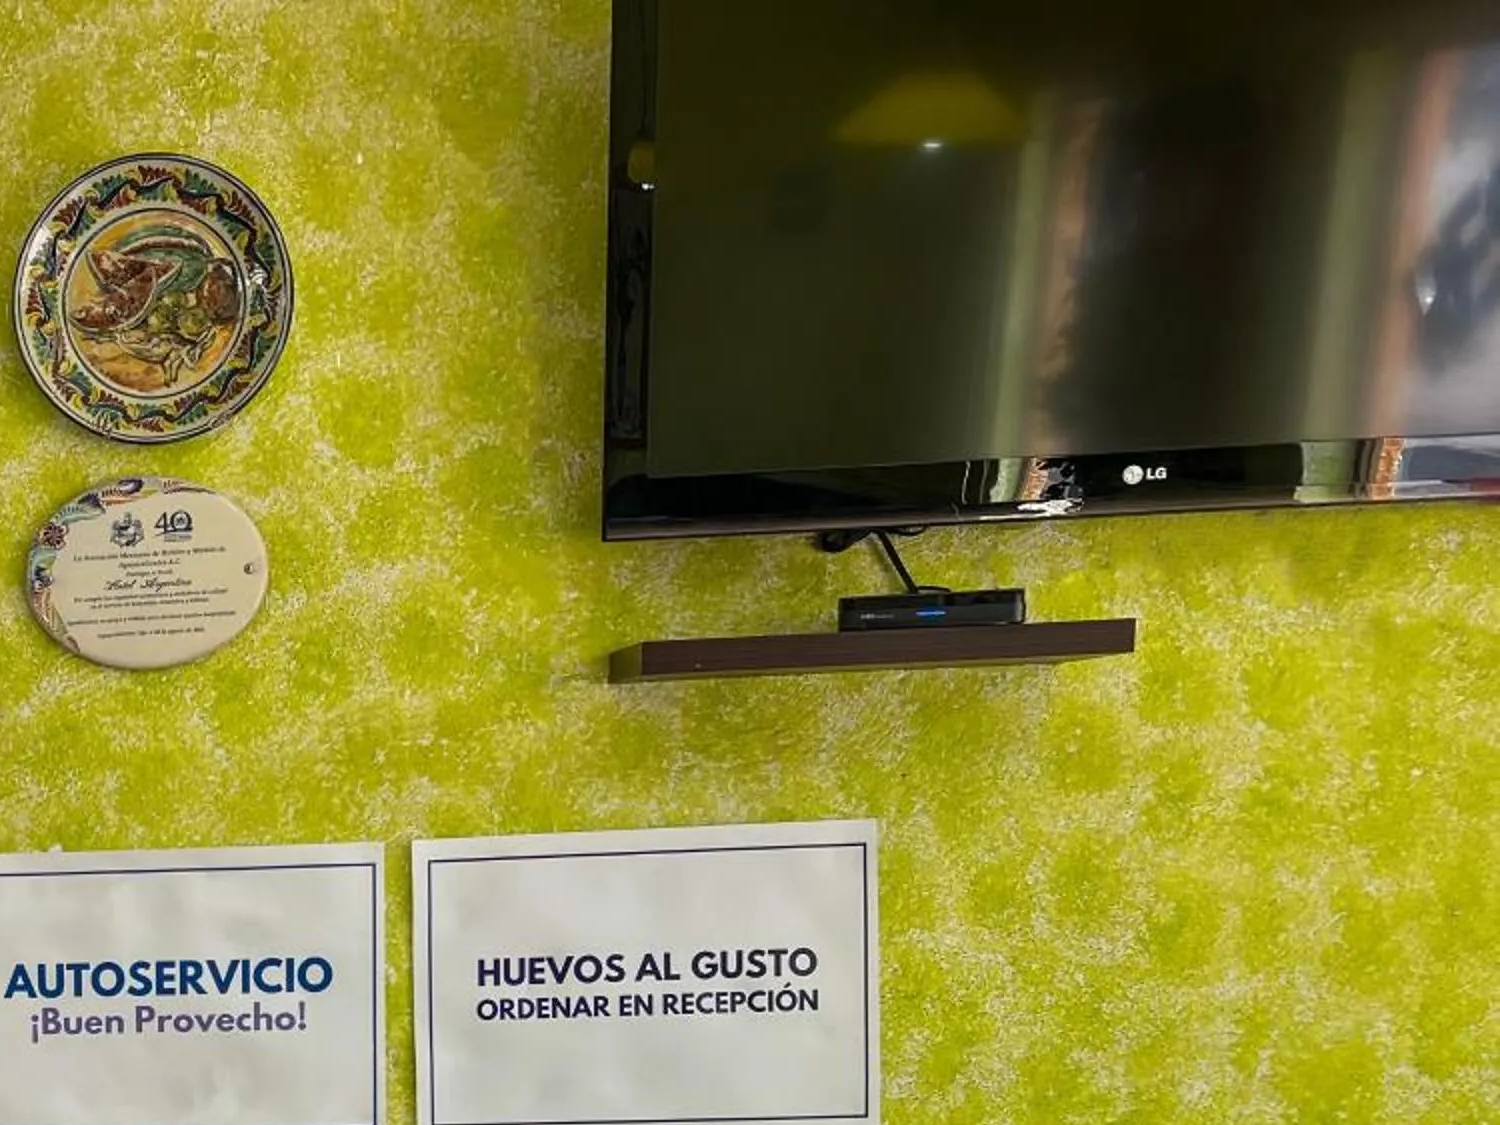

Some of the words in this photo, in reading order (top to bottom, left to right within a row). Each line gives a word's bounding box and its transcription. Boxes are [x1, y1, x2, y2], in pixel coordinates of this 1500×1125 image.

[1146, 466, 1168, 480] LG
[3, 957, 333, 999] AUTOSERVICIO
[477, 953, 626, 987] HUEVOS
[635, 951, 681, 982] AL
[691, 947, 818, 980] GUSTO
[476, 995, 611, 1021] ORDENAR
[619, 993, 654, 1017] EN
[662, 982, 819, 1016] RECEPCIÓN
[31, 1007, 125, 1044] ¡Buen
[135, 1001, 307, 1033] Provecho!
